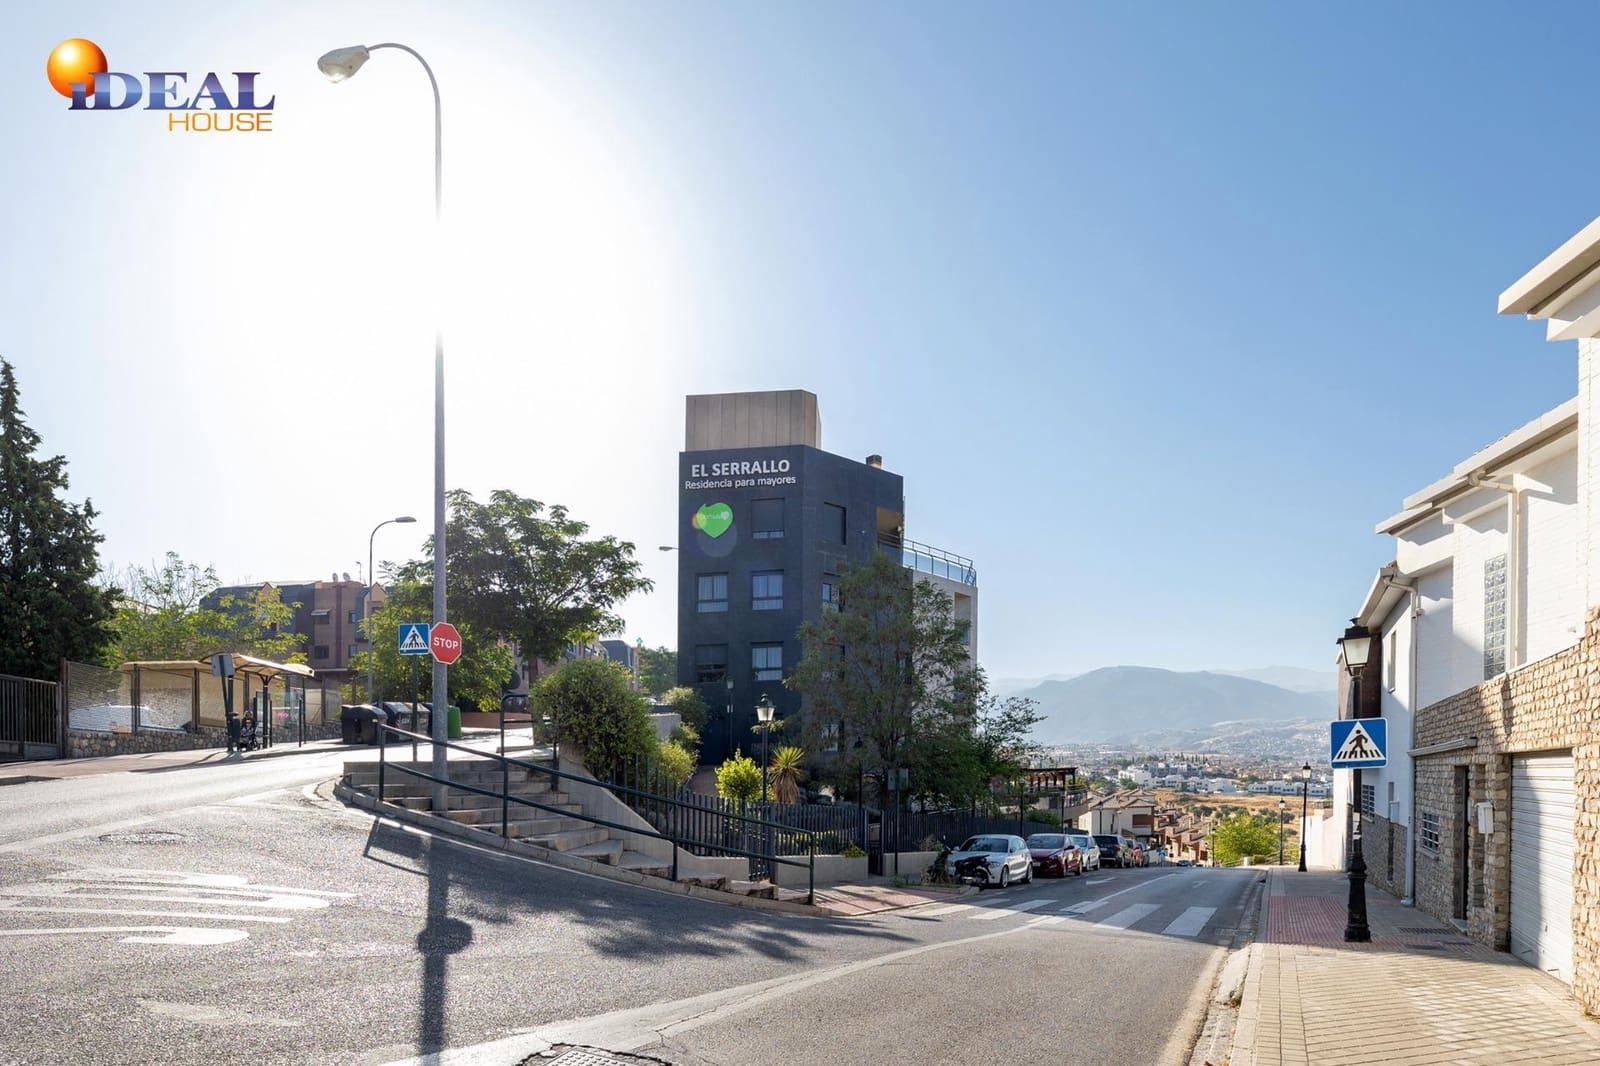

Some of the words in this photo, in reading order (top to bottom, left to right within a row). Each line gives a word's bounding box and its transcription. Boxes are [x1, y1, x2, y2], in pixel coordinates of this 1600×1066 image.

[691, 464, 708, 478] EL
[712, 459, 790, 476] SERRALLO
[685, 479, 732, 490] Residencia
[735, 479, 755, 489] para
[758, 476, 796, 487] mayores
[433, 637, 459, 649] STOP
